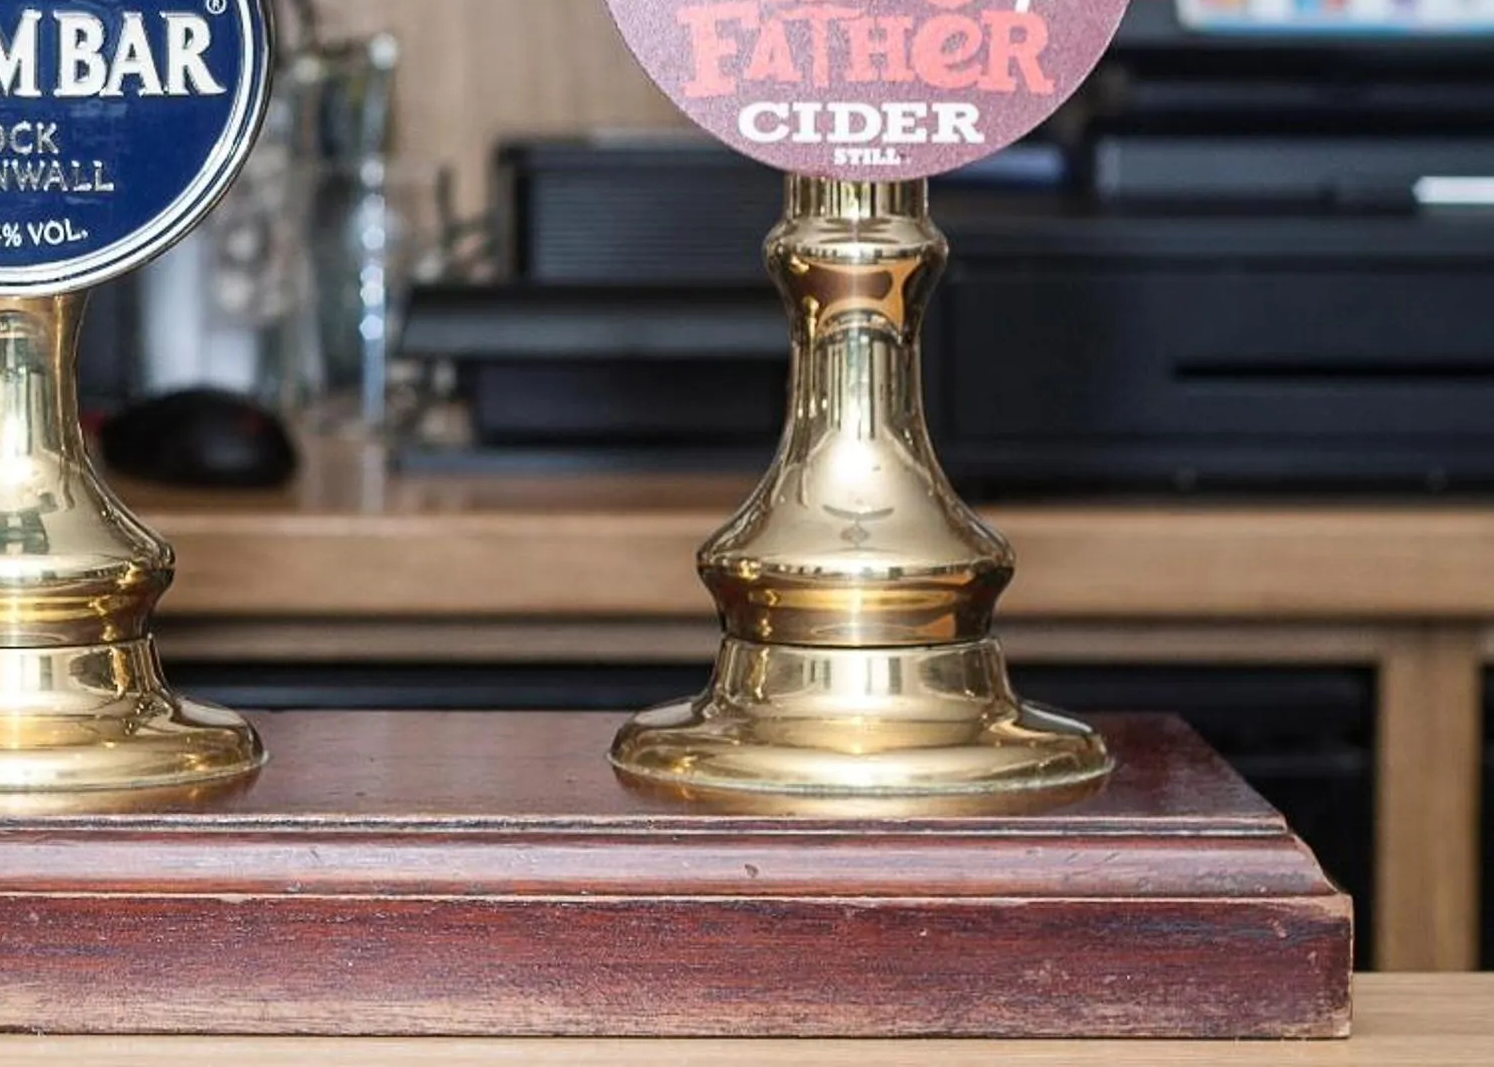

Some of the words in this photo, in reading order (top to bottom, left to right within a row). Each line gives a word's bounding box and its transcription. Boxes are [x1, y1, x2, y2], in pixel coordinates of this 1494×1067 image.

[53, 10, 228, 98] BAR
[737, 101, 985, 145] CIDER
[833, 148, 902, 165] STILL
